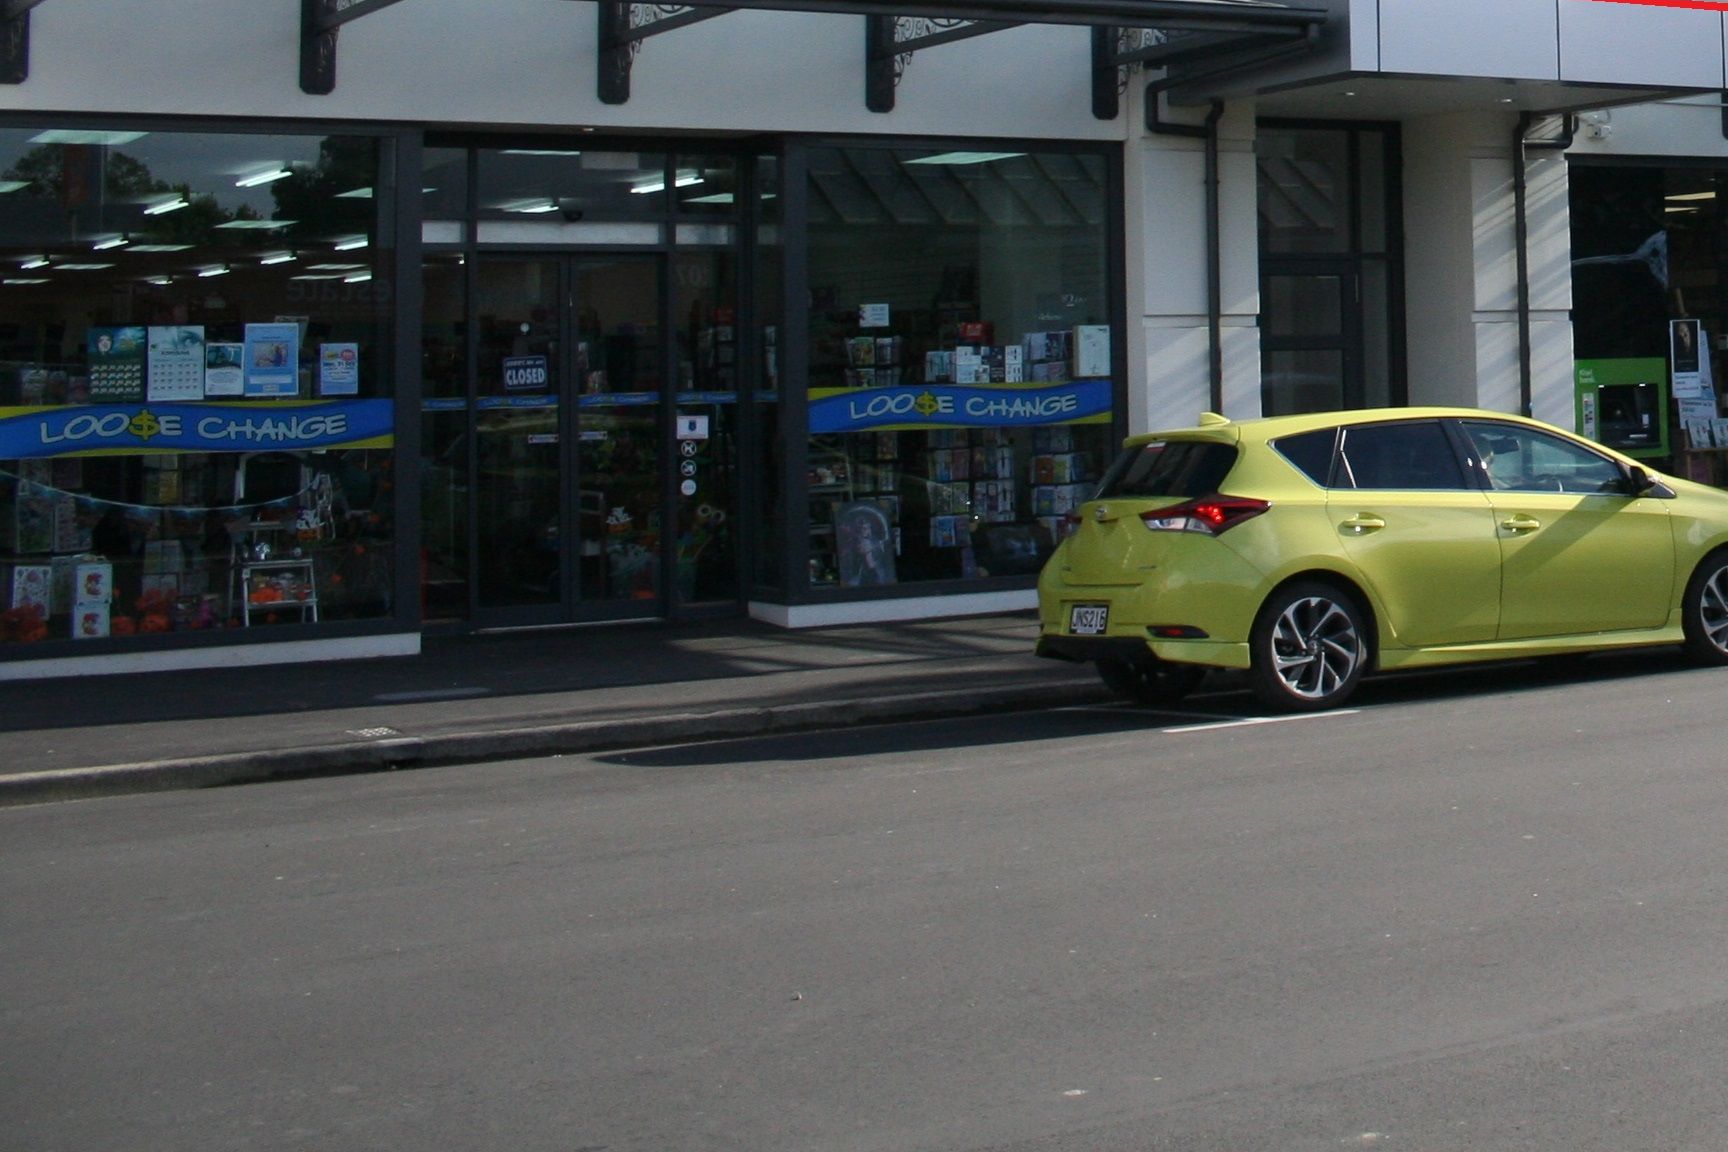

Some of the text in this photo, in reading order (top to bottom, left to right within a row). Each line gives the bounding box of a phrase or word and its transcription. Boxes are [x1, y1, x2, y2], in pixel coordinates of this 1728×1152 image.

[506, 367, 546, 386] CLOSED
[966, 394, 1078, 418] CHANGE
[197, 414, 348, 441] CHANGE
